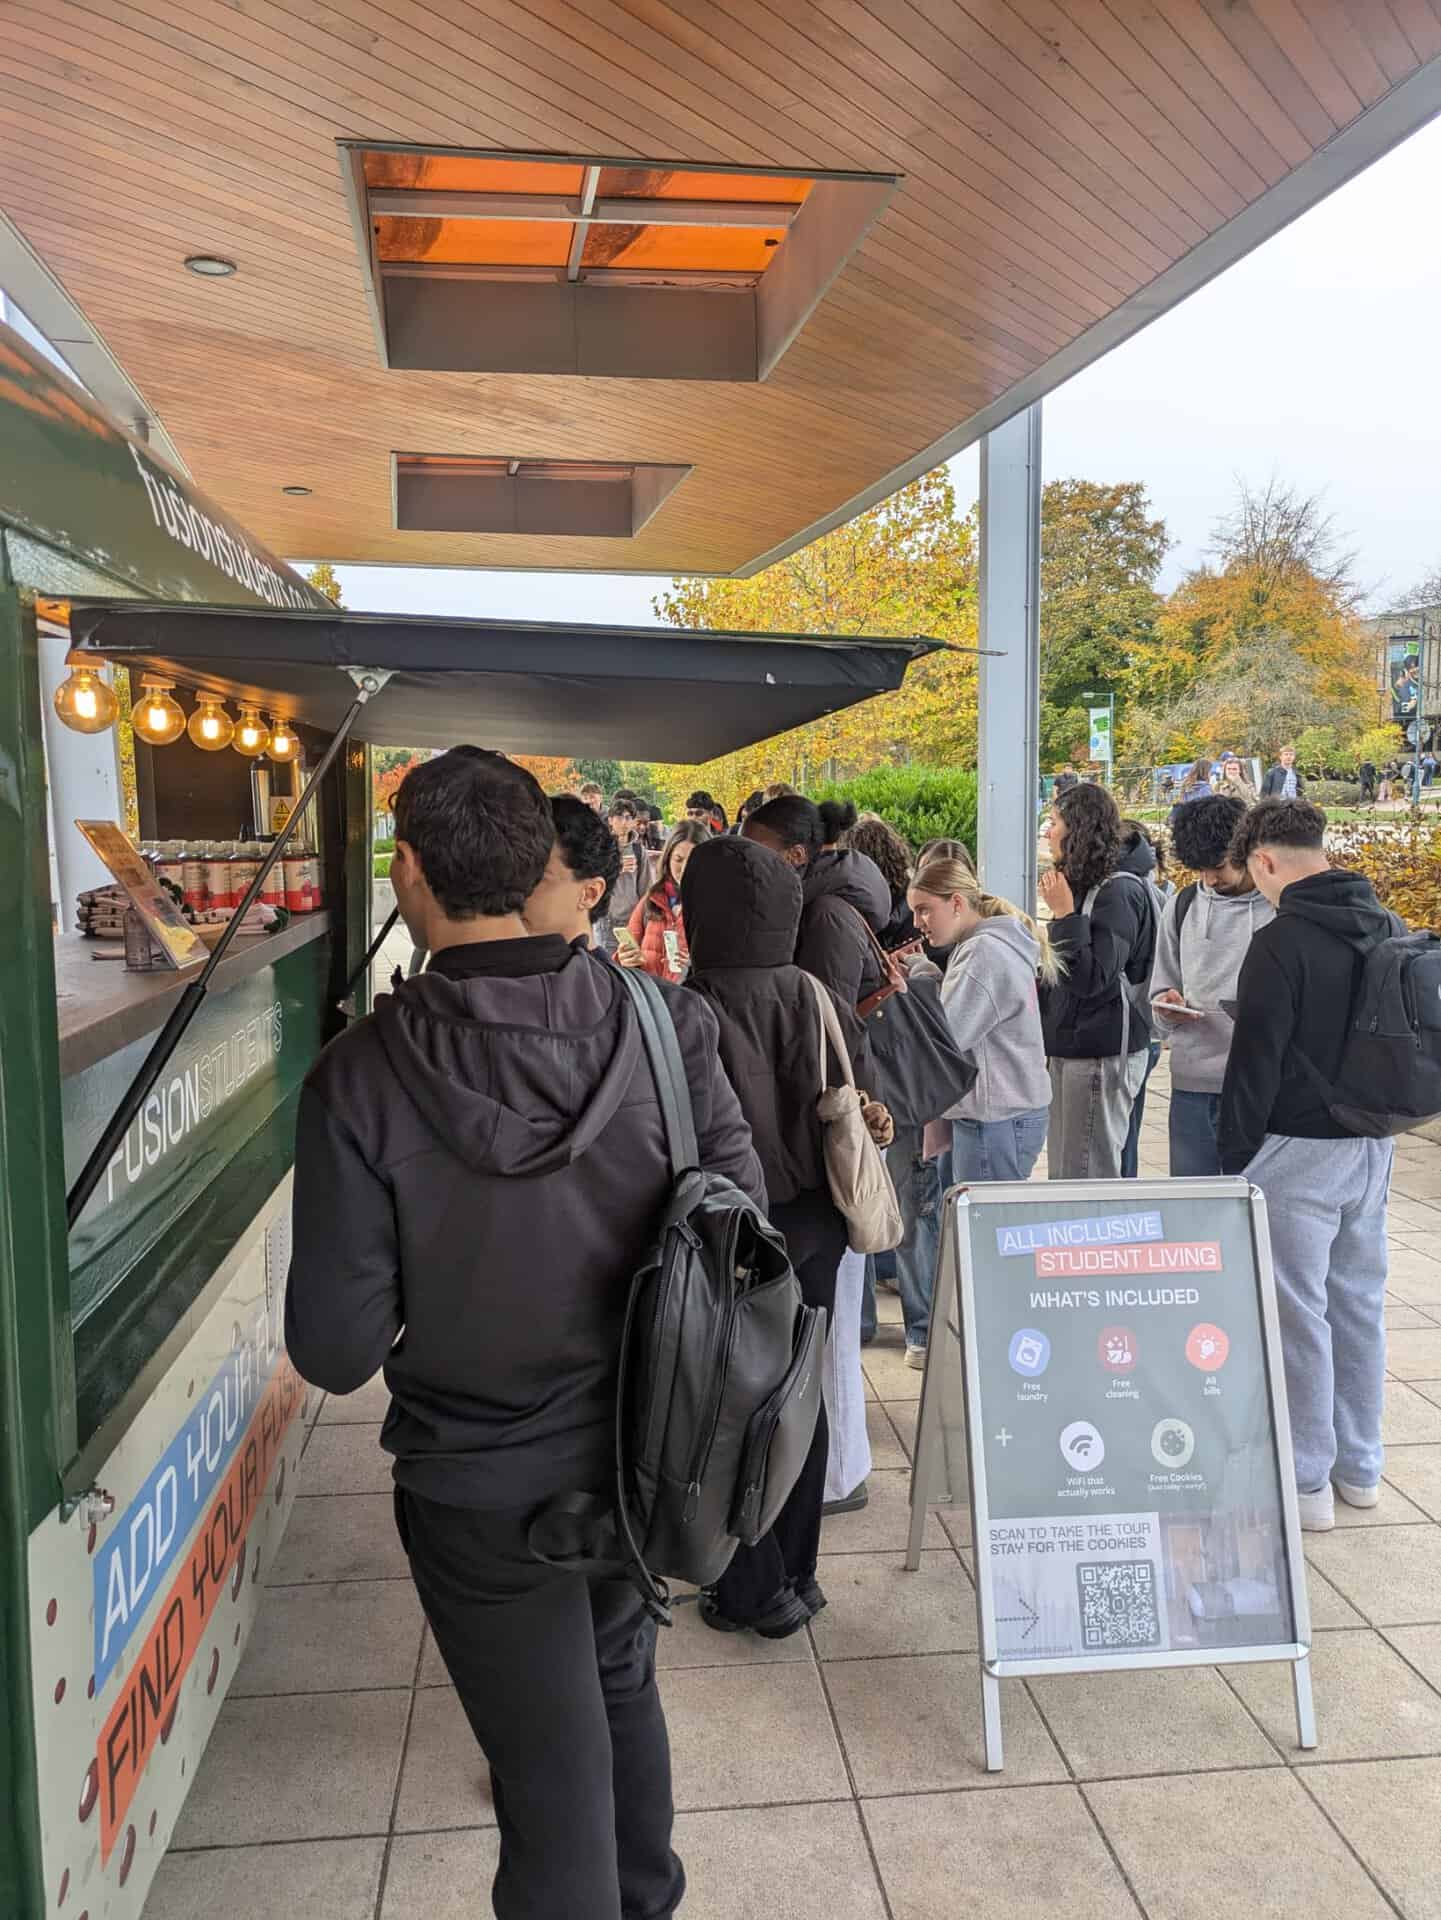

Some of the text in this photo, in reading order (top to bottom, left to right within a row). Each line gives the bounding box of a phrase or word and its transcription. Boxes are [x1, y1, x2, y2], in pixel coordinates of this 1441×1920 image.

[1003, 1216, 1161, 1250] ALL INCLUSIVE
[1040, 1246, 1217, 1272] STUDENT LIVING
[1029, 1288, 1200, 1309] WHAT'S INCLUDED
[1023, 1382, 1041, 1391] Free
[1112, 1379, 1131, 1388] Free
[1017, 1391, 1048, 1402] laundry
[1105, 1389, 1140, 1400] cleaning
[1087, 1476, 1104, 1485] that
[1150, 1473, 1203, 1482] Free Cookies
[1057, 1486, 1116, 1498] actually works
[100, 1465, 178, 1663] ADD
[187, 1340, 252, 1501] YOUR
[990, 1522, 1151, 1541] SCAN TO TAKE THE TOUR
[991, 1537, 1147, 1555] STAY FOR THE COOKIES
[106, 1596, 184, 1824] FIND
[193, 1436, 257, 1617] YOUR
